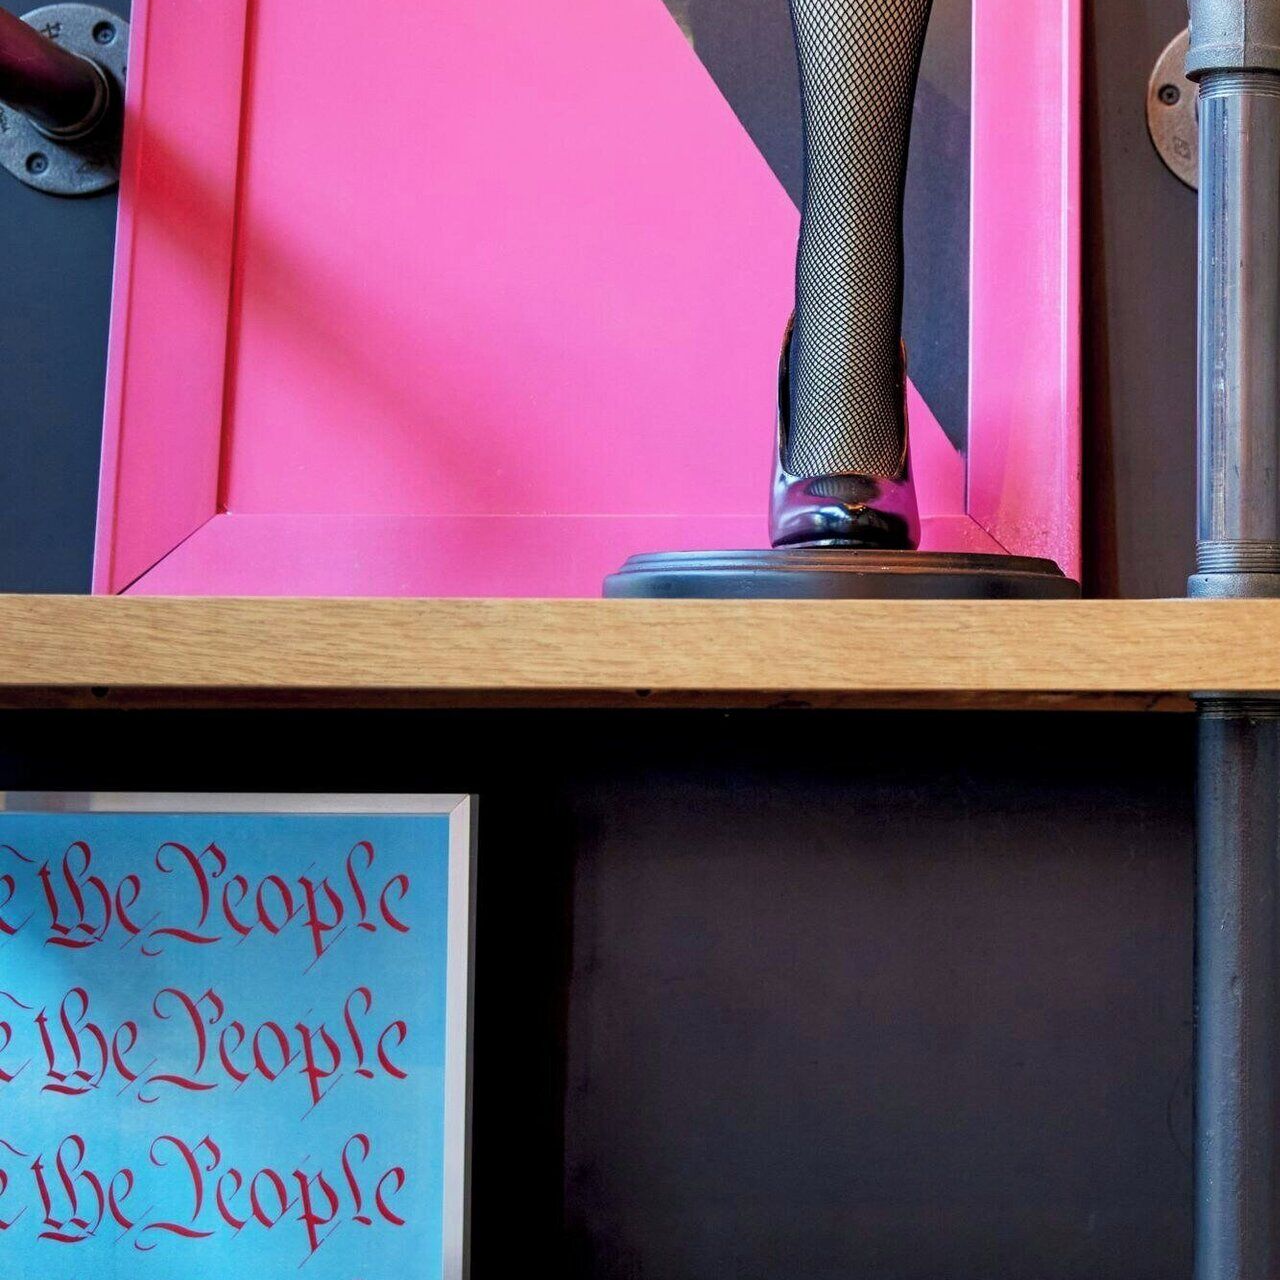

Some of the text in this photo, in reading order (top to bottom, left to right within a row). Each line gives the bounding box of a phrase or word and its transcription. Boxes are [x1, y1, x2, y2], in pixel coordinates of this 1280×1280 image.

[141, 840, 411, 977] People
[138, 986, 409, 1121] People
[134, 1133, 407, 1269] People
